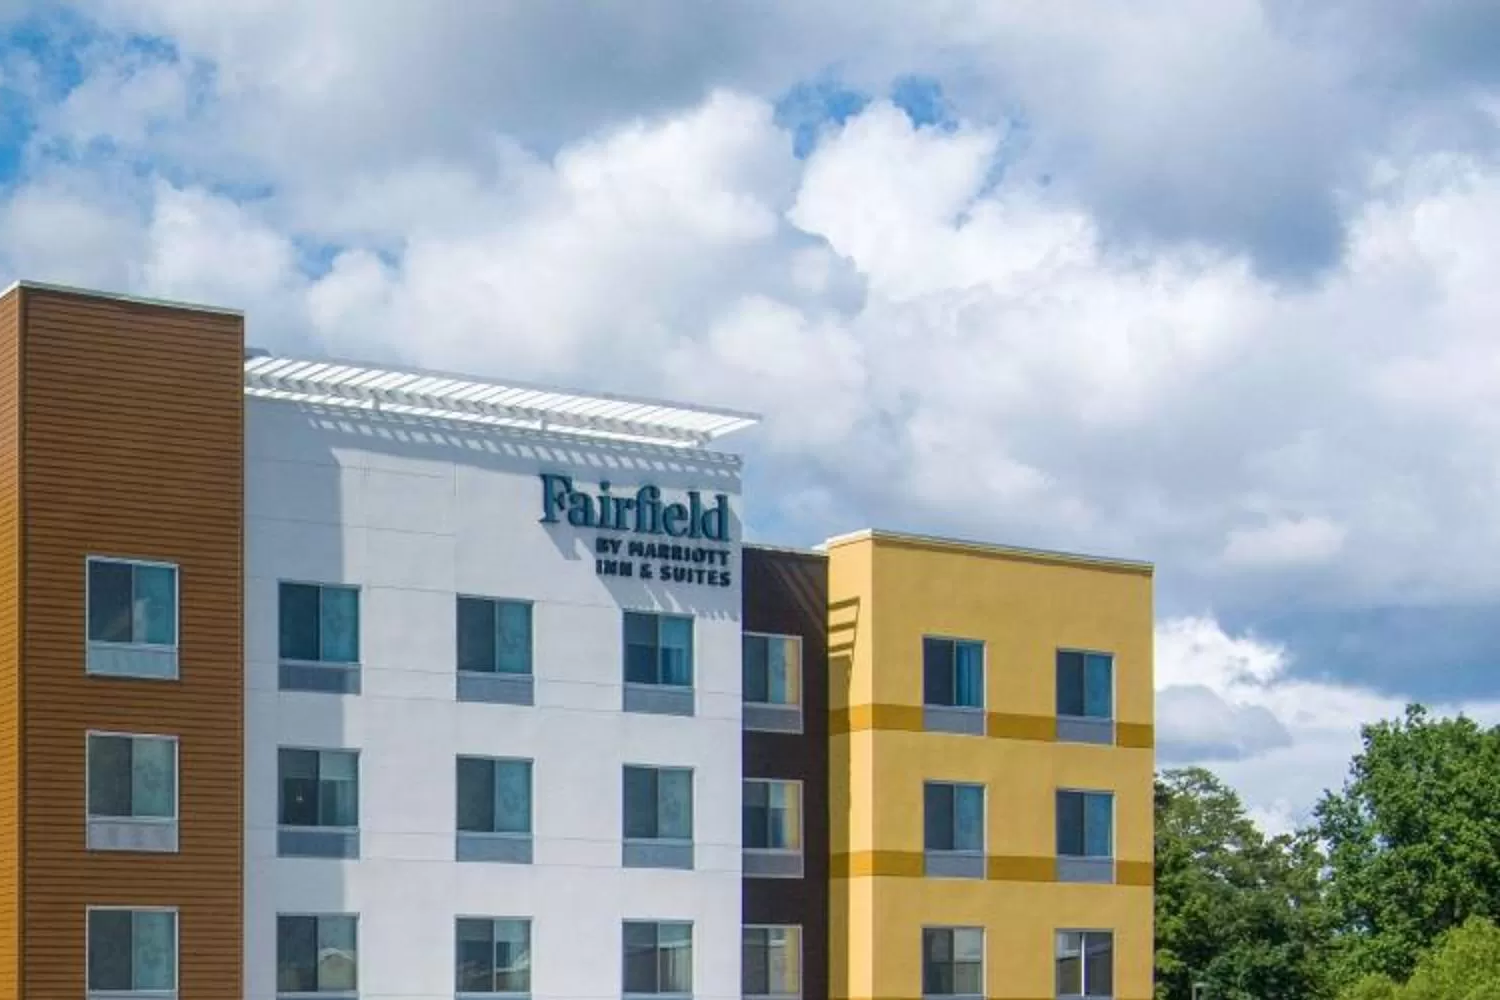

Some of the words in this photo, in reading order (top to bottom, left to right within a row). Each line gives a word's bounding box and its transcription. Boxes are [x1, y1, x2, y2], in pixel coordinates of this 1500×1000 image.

[538, 473, 730, 542] Fairfield
[595, 537, 622, 555] BY
[628, 540, 731, 566] MARRIOTT
[595, 559, 633, 577] INN
[639, 563, 653, 580] &
[659, 564, 731, 587] SUITES
